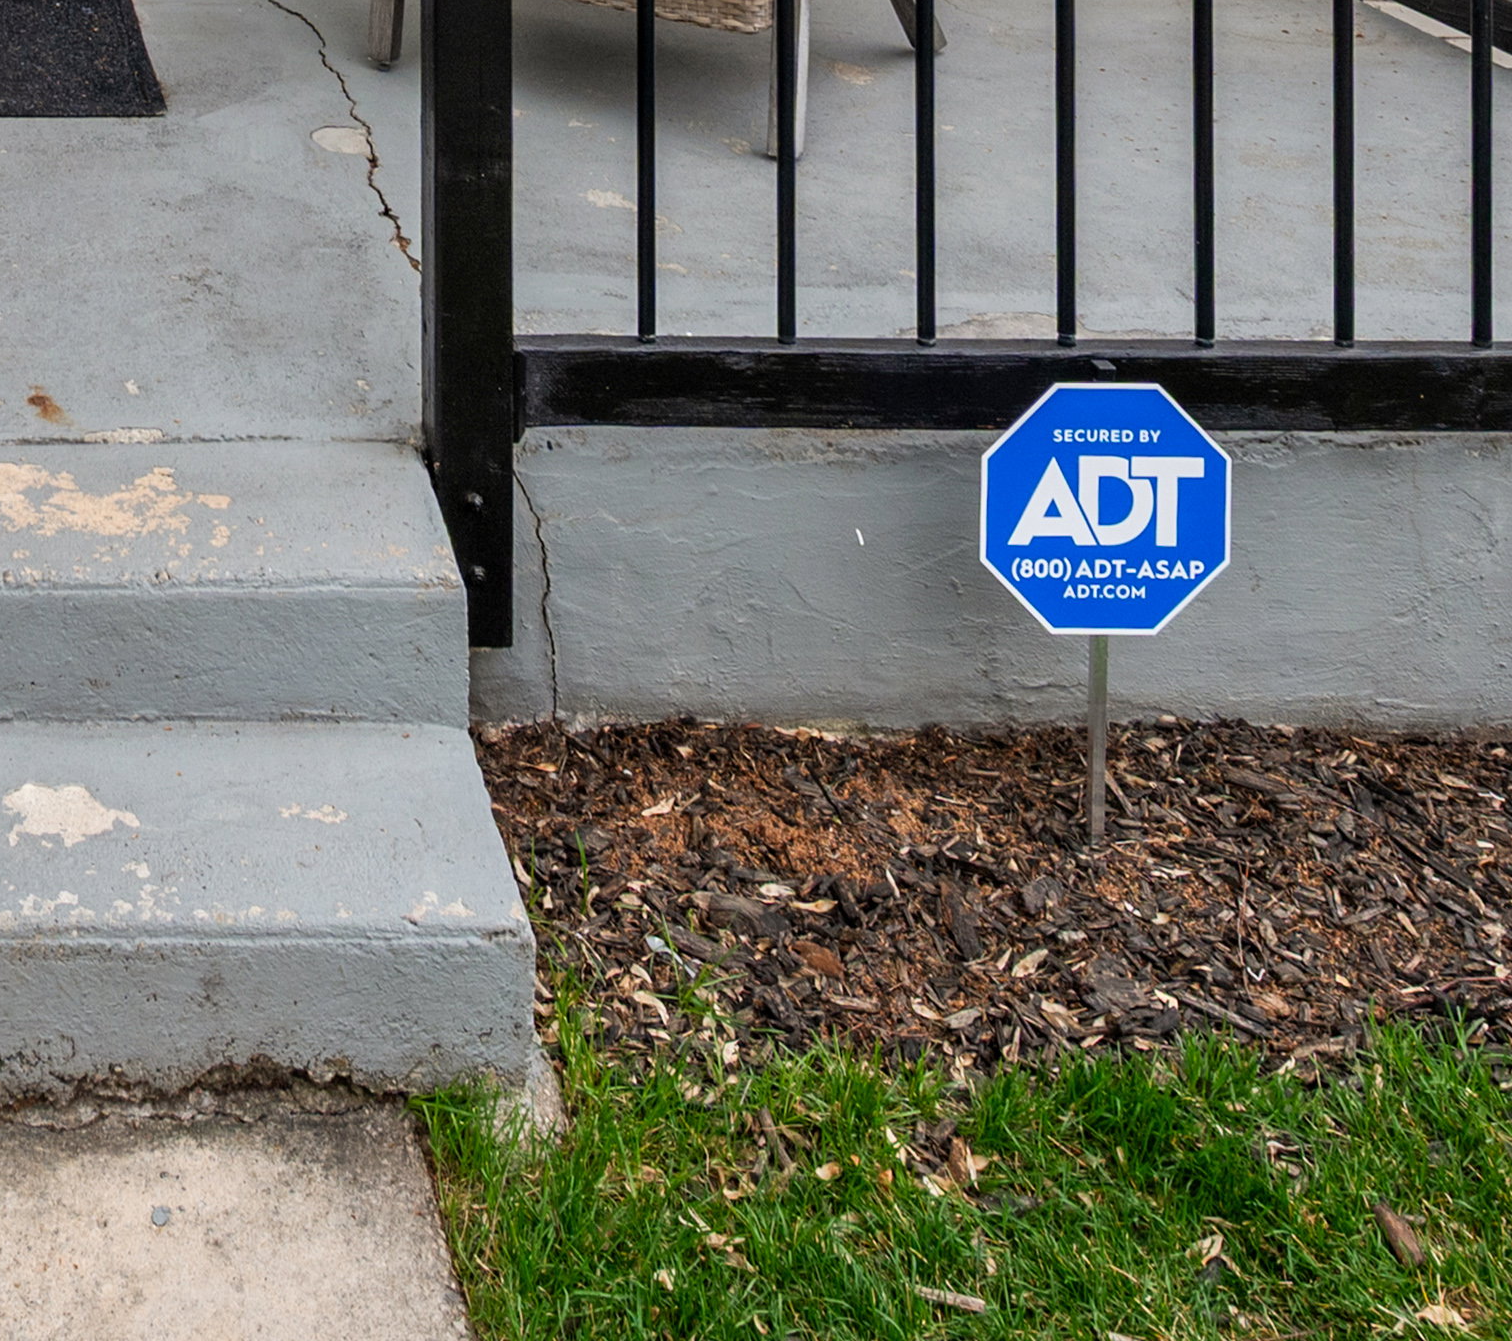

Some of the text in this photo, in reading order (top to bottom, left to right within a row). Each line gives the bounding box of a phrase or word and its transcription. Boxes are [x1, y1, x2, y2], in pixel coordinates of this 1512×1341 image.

[1053, 428, 1161, 443] SECURED BY
[1007, 455, 1205, 547] ADT
[1011, 557, 1205, 582] (800) ADT-ASAP
[1063, 584, 1146, 599] ADT.COM
